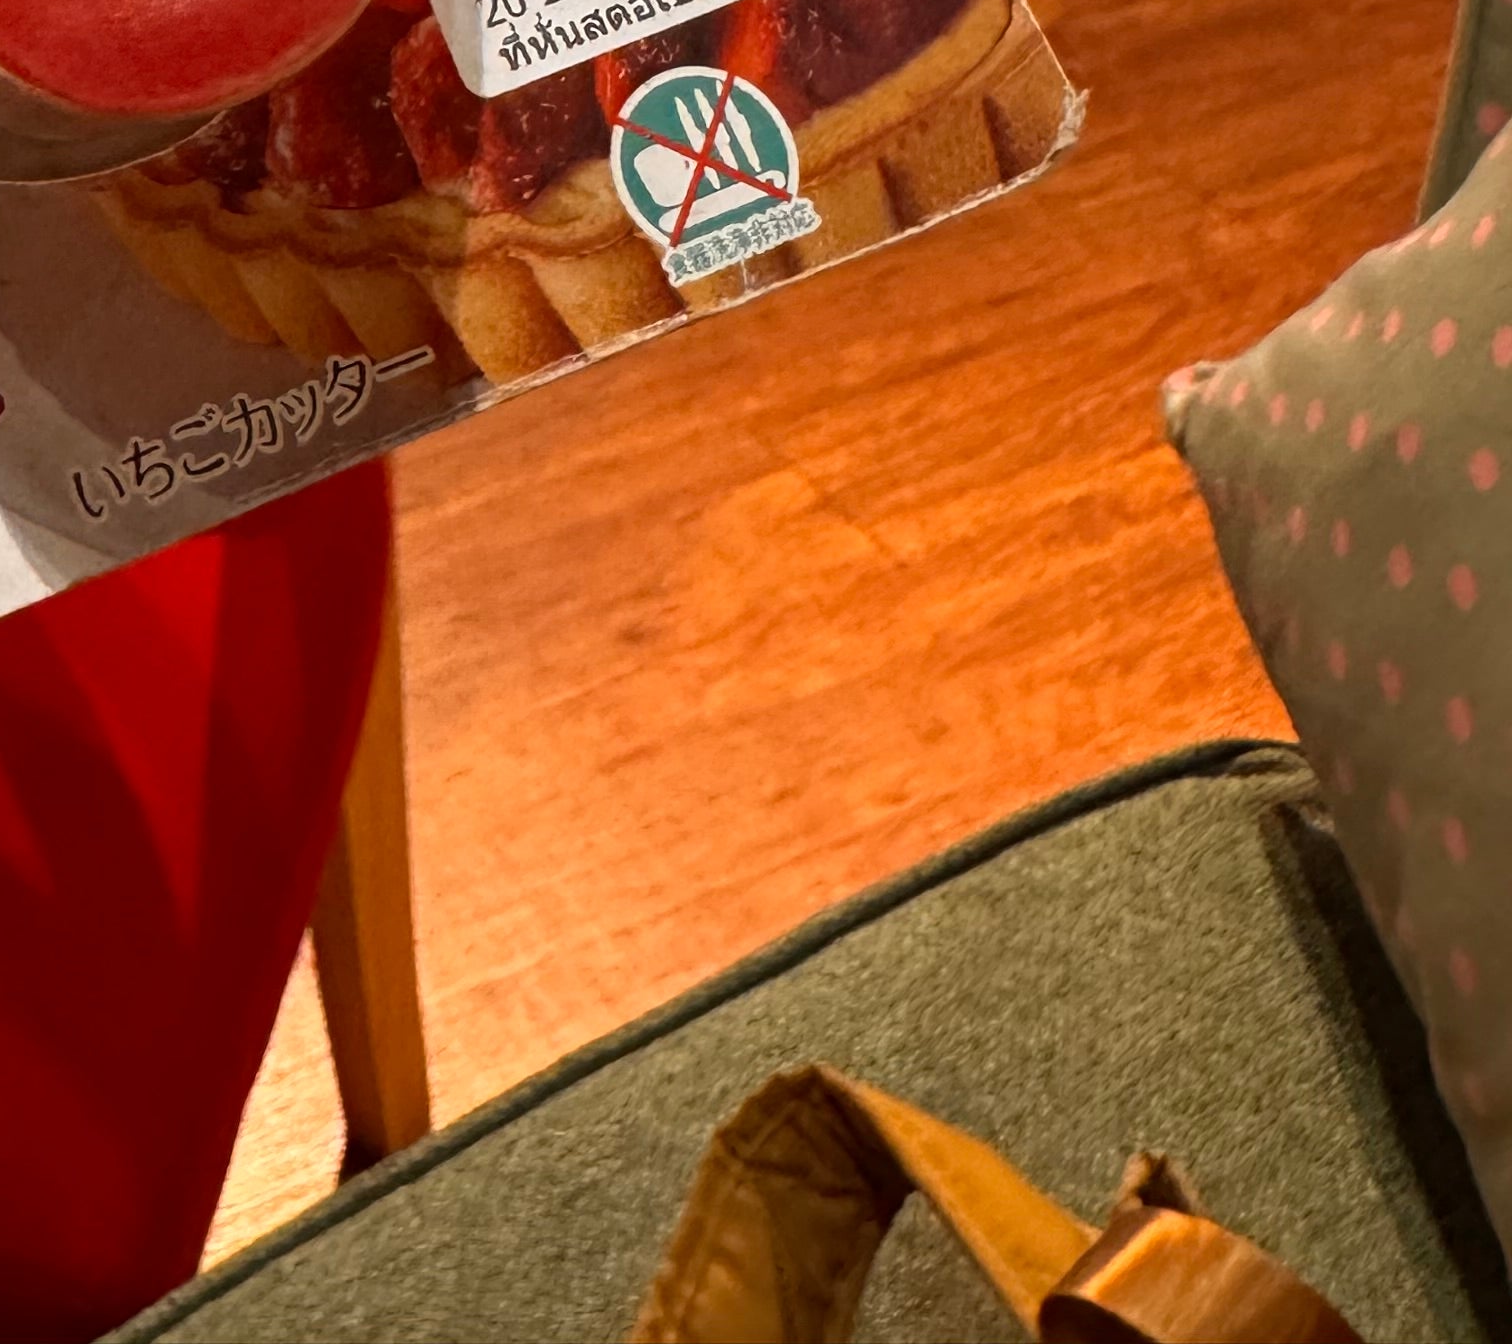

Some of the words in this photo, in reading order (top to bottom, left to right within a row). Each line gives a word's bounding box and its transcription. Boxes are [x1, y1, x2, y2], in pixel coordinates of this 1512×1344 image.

[72, 344, 436, 519] いちごカッター
